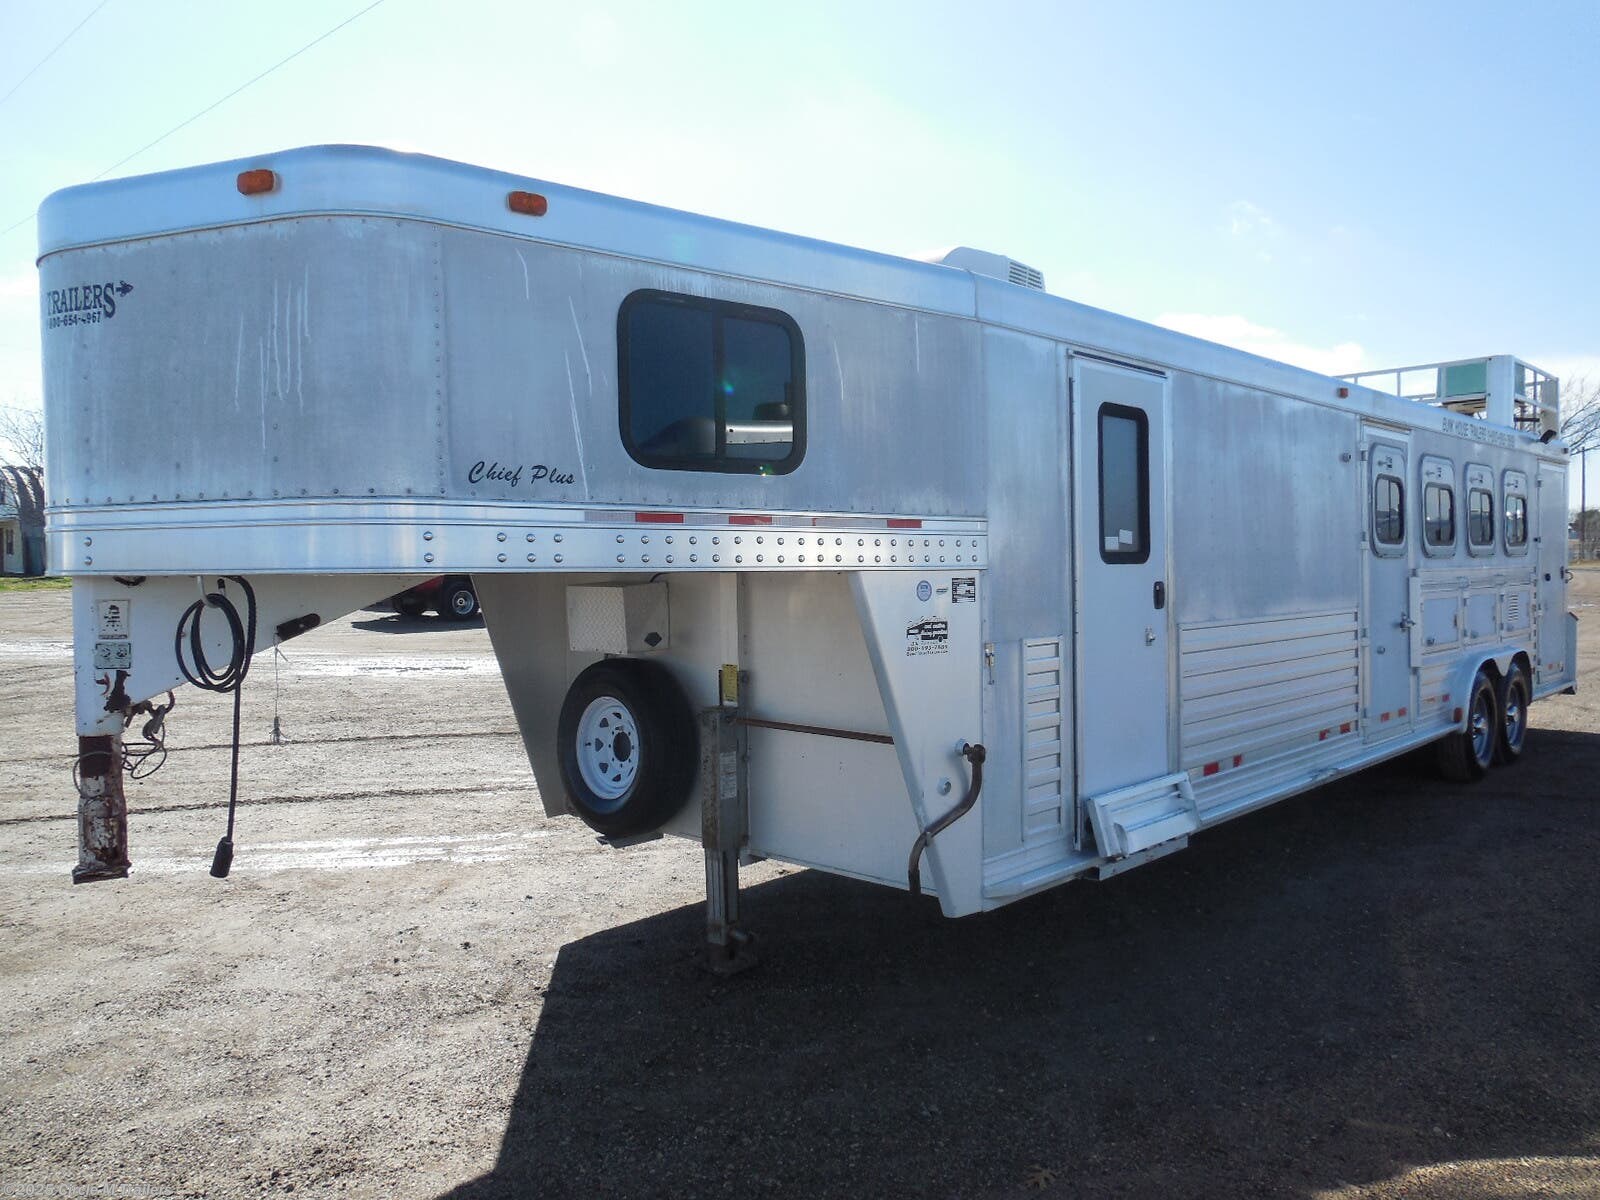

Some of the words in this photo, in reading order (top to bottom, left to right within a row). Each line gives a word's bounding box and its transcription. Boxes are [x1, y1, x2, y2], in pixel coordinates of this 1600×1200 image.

[47, 282, 116, 319] TRAILERS
[468, 461, 523, 487] Chief
[531, 464, 576, 485] Plus
